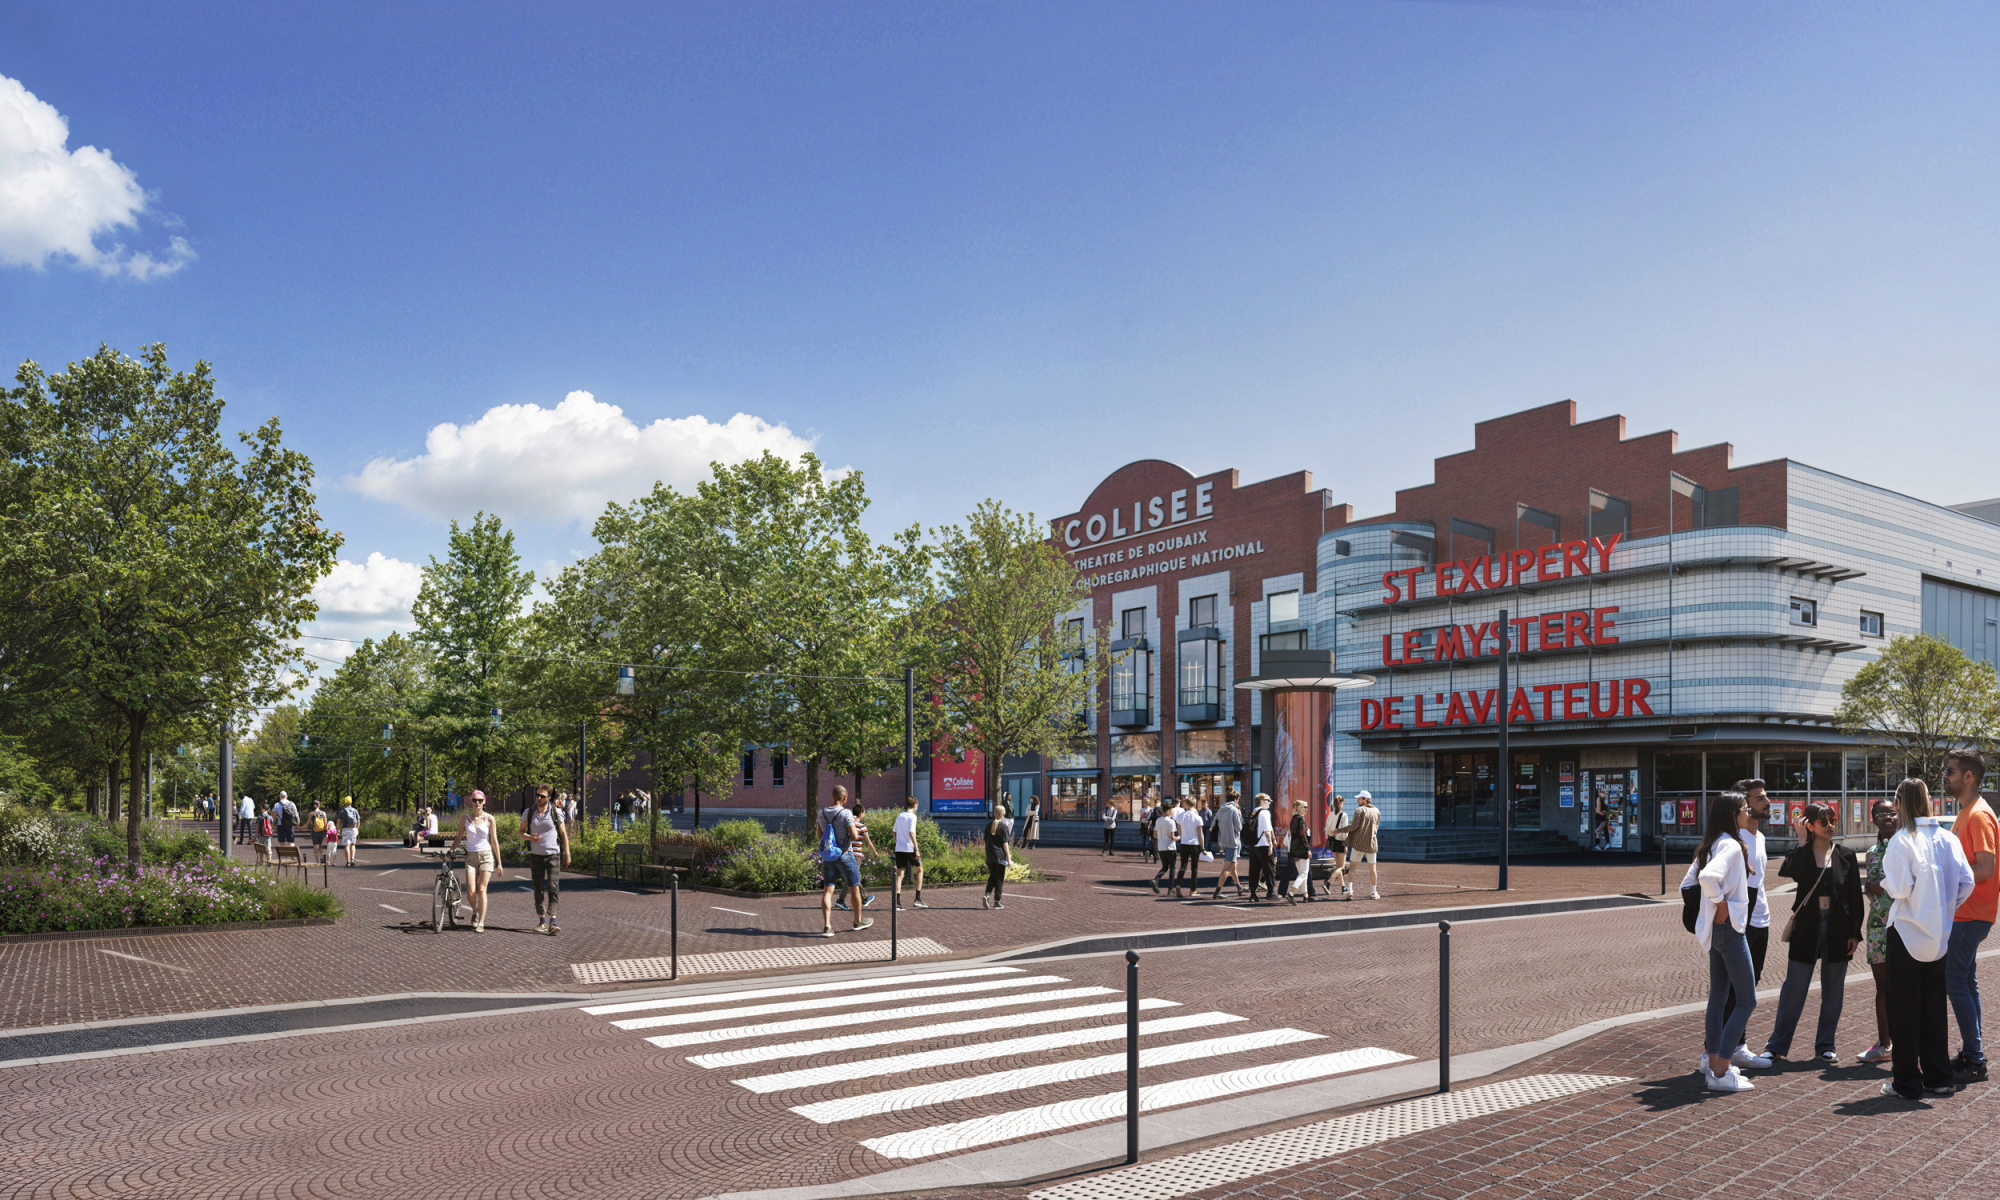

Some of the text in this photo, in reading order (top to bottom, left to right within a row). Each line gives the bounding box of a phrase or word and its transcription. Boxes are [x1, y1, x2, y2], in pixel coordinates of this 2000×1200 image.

[1064, 481, 1214, 549] COLISEE
[1074, 530, 1208, 571] THEATRE DE ROUBAIX
[1076, 540, 1265, 590] CHOREGRAPHIQUE NATIONAL
[1382, 532, 1623, 604] ST EXUPERY
[1382, 606, 1620, 666] LE MYSTERE
[1360, 696, 1404, 730] DE
[952, 777, 974, 786] Colisée
